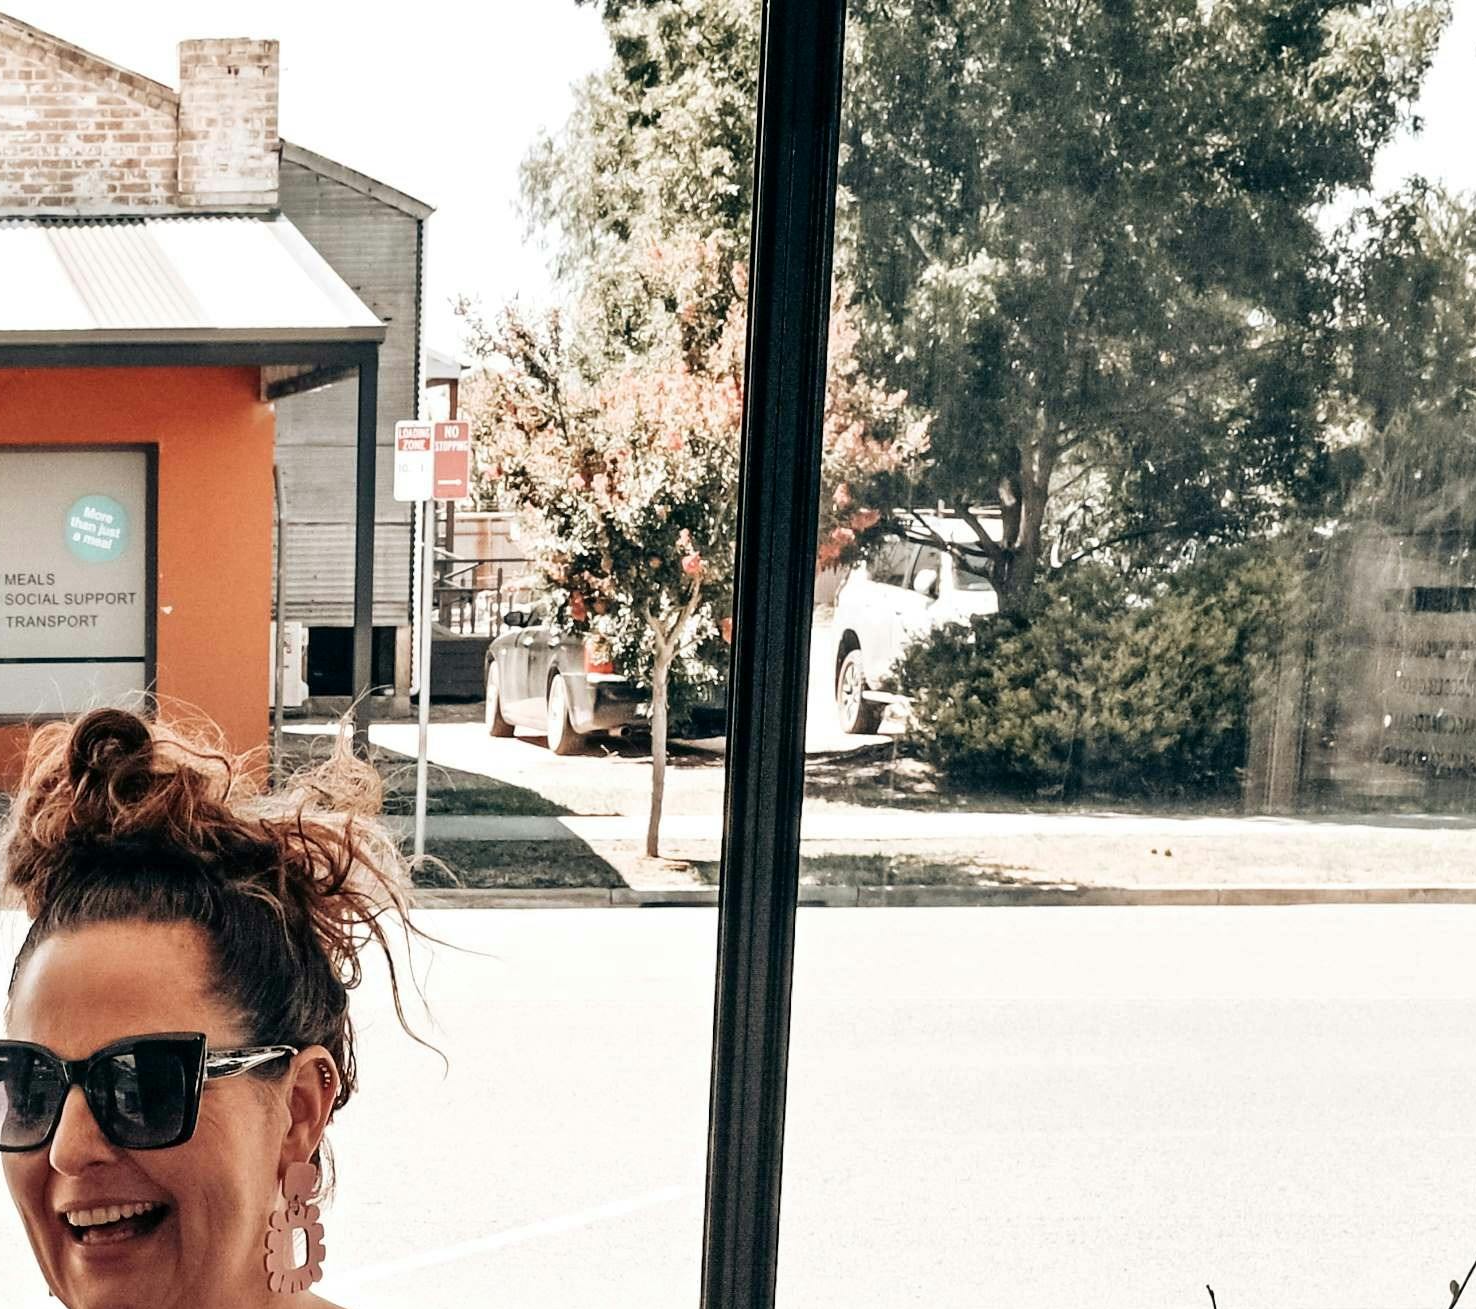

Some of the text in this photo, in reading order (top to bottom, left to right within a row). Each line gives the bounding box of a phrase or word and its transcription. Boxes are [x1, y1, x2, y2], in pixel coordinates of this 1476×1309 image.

[444, 426, 460, 439] NO
[83, 507, 114, 524] More
[70, 516, 121, 539] than just
[72, 532, 81, 542] a
[4, 573, 56, 586] MEALS
[5, 592, 136, 606] SOCIAL SUPPORT
[7, 615, 98, 628] TRANSPORT
